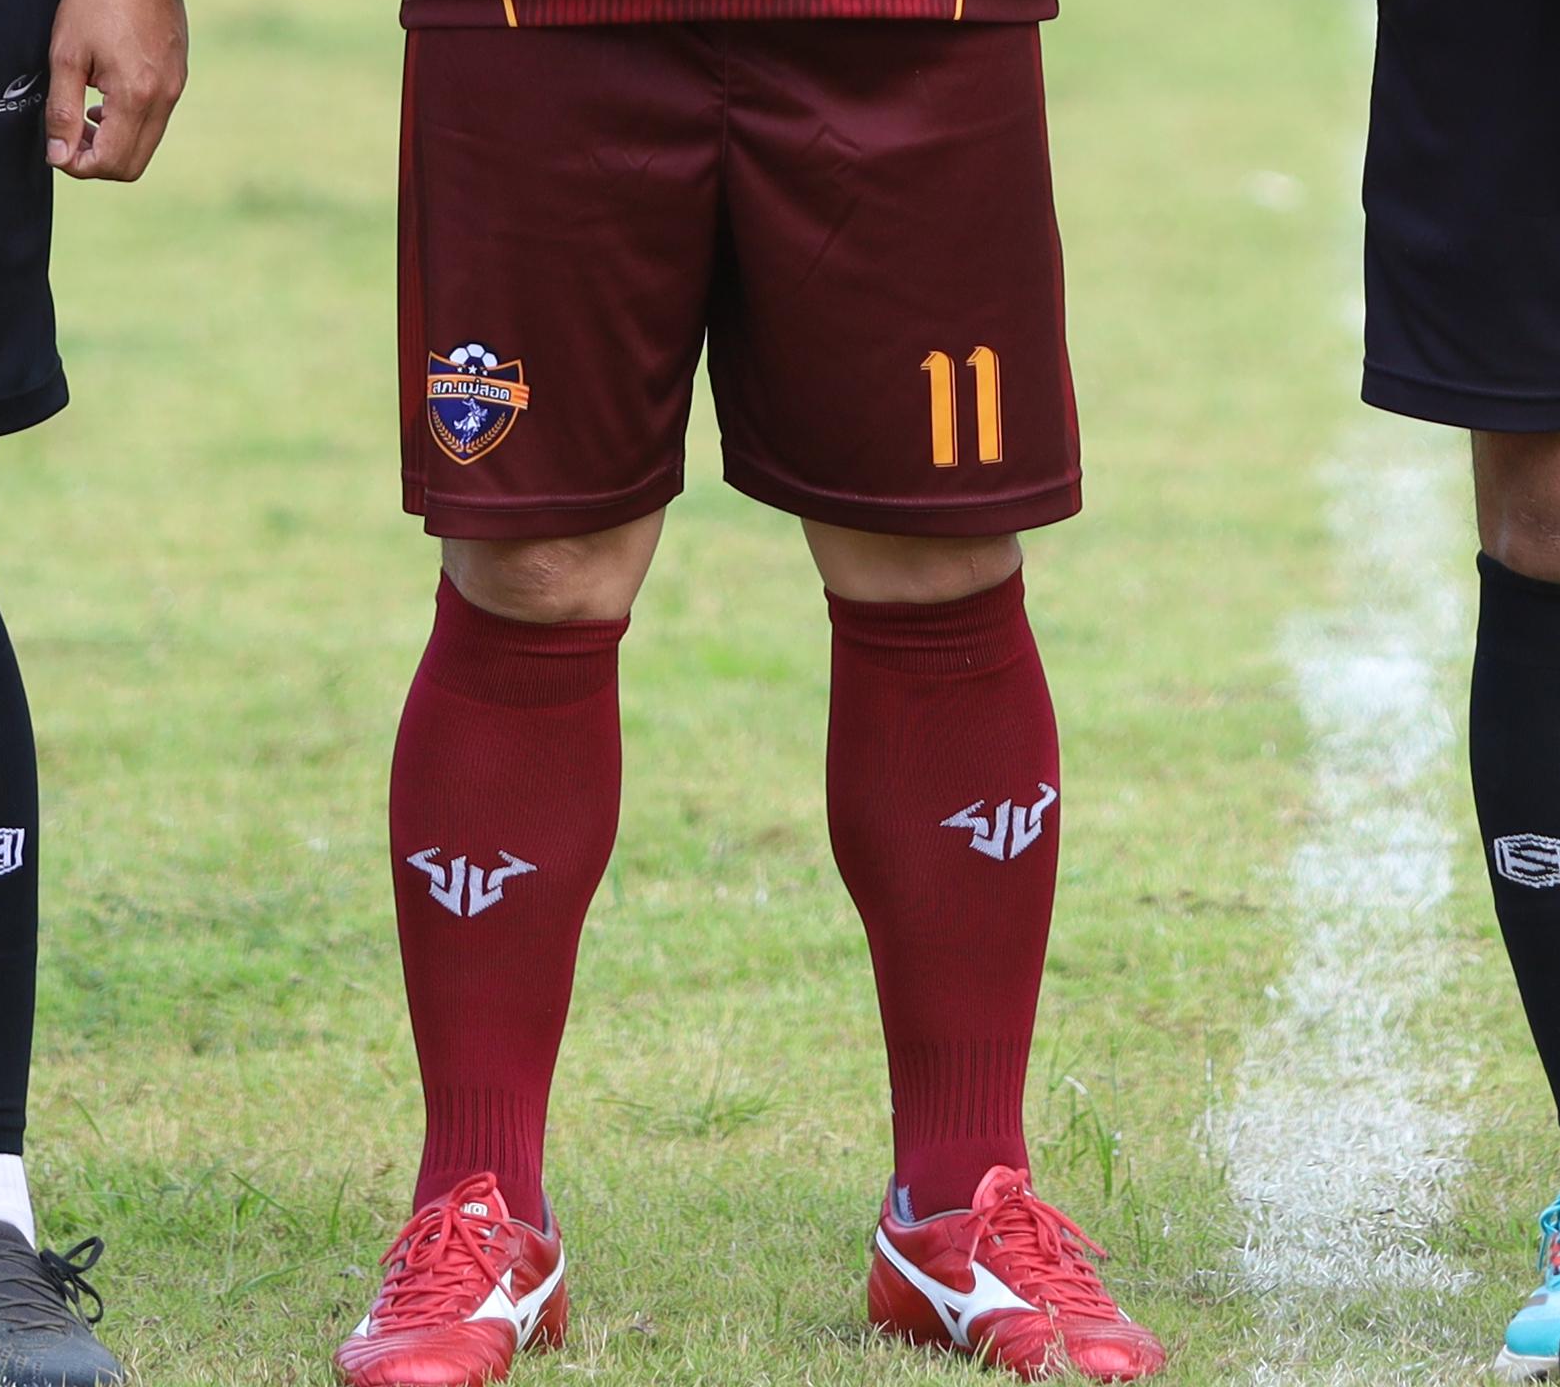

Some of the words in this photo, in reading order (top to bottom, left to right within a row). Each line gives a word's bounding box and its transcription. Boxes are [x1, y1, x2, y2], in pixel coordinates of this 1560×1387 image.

[431, 379, 510, 401] สภ.แม่สอด
[919, 346, 1003, 467] 11
